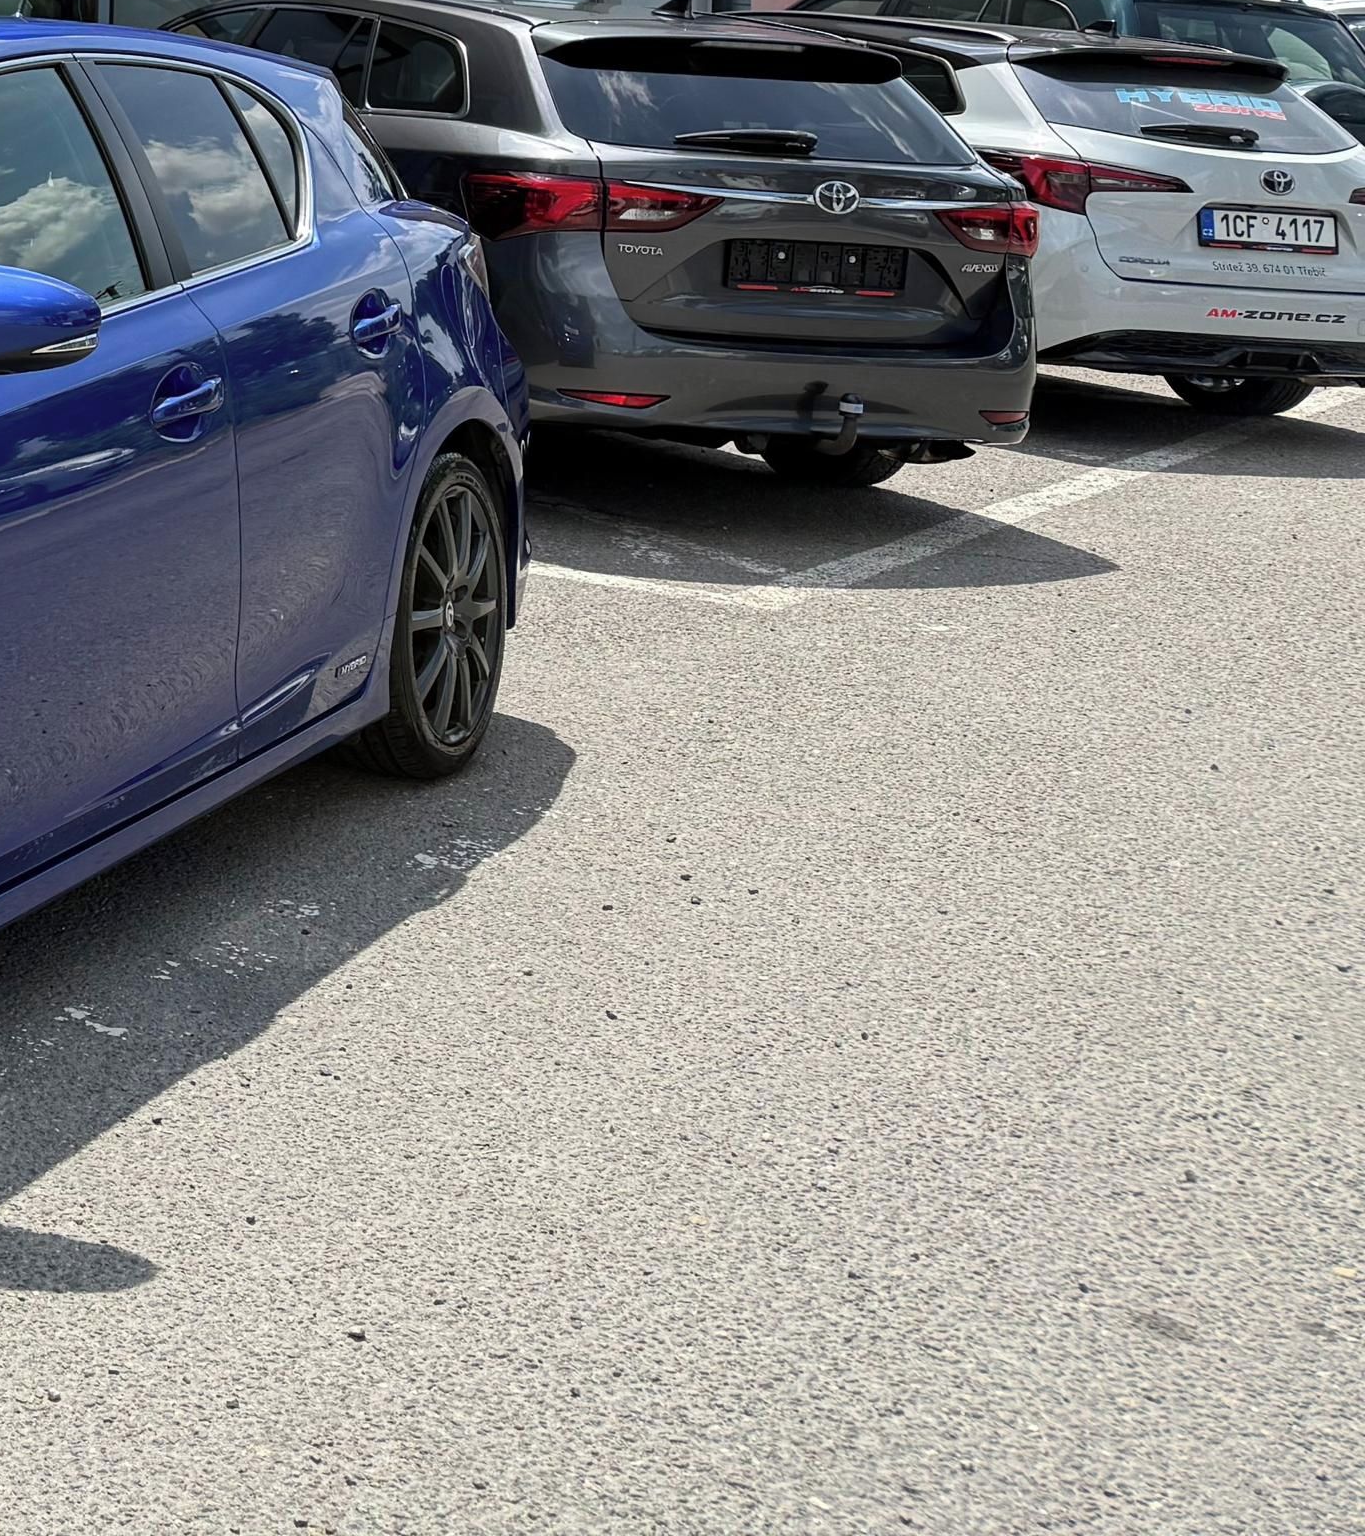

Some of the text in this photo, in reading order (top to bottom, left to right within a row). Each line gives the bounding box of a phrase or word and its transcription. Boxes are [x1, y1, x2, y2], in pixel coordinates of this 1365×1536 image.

[1115, 88, 1282, 113] HYBRID
[1220, 213, 1325, 243] 1CF 4117
[617, 243, 664, 256] TOYOTA
[961, 263, 999, 273] AVENSIS
[1263, 263, 1281, 274] 674
